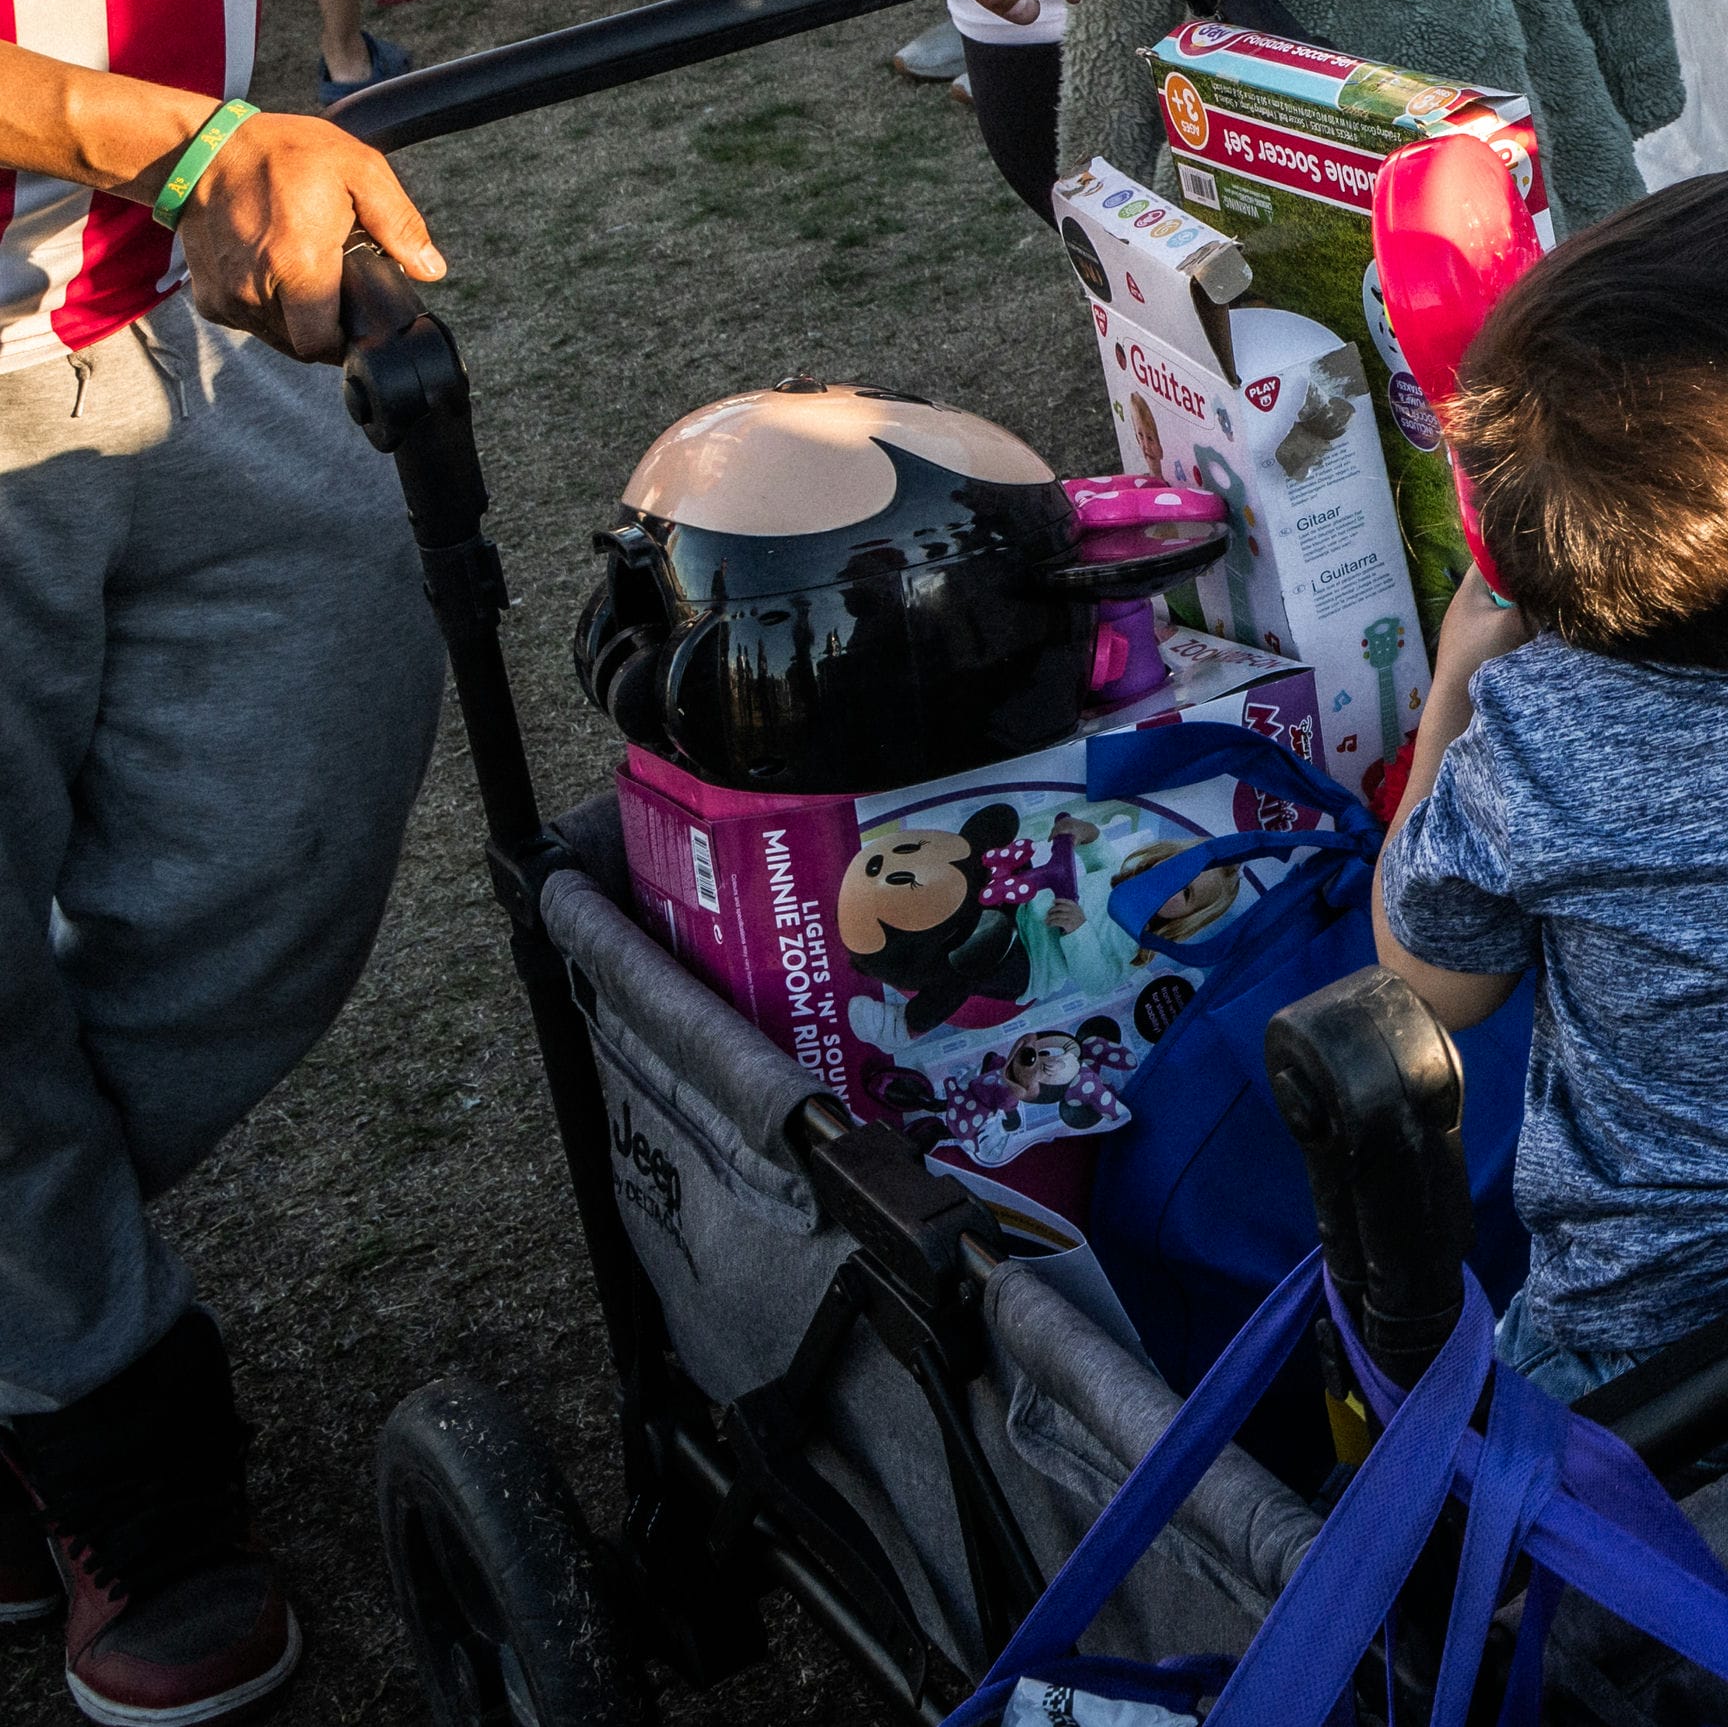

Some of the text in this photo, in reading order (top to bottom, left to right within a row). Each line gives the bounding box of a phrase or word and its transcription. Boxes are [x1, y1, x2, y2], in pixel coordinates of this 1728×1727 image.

[1330, 53, 1355, 68] Set
[1171, 87, 1200, 121] 3+
[1180, 120, 1200, 137] AGES
[1223, 129, 1377, 194] able Soccer Set
[1131, 344, 1206, 420] Guitar
[1249, 381, 1277, 399] PLAY
[1296, 504, 1341, 532] Gitaar
[1320, 551, 1378, 585] Guitarra
[762, 829, 799, 929] MINNIE
[779, 935, 814, 1018] ZOOM
[801, 900, 830, 983] LIGHTS
[816, 992, 839, 1024] 'N'
[613, 1100, 682, 1214] Jeep
